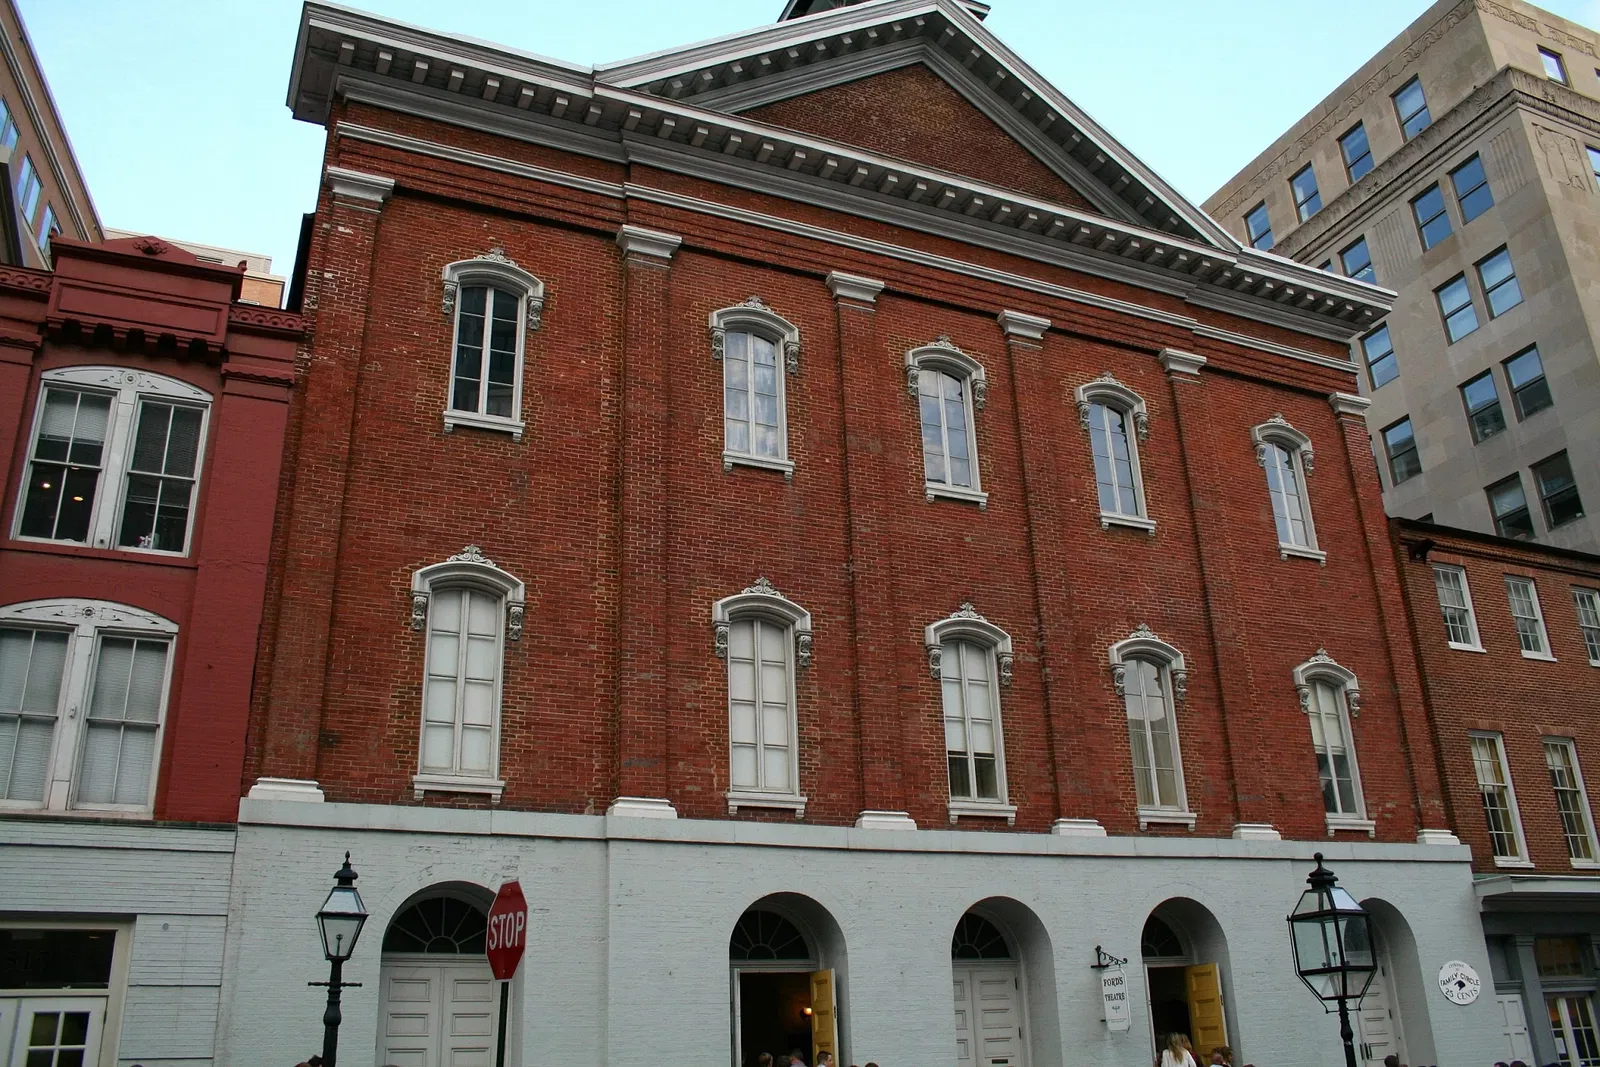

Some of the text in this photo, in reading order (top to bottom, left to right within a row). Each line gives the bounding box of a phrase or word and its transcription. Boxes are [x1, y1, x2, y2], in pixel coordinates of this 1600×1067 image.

[489, 911, 525, 951] STOP
[1440, 972, 1480, 986] FAMILY CIRCLE
[1104, 992, 1125, 1002] THEATRE
[1445, 987, 1479, 1000] 25 CENTS
